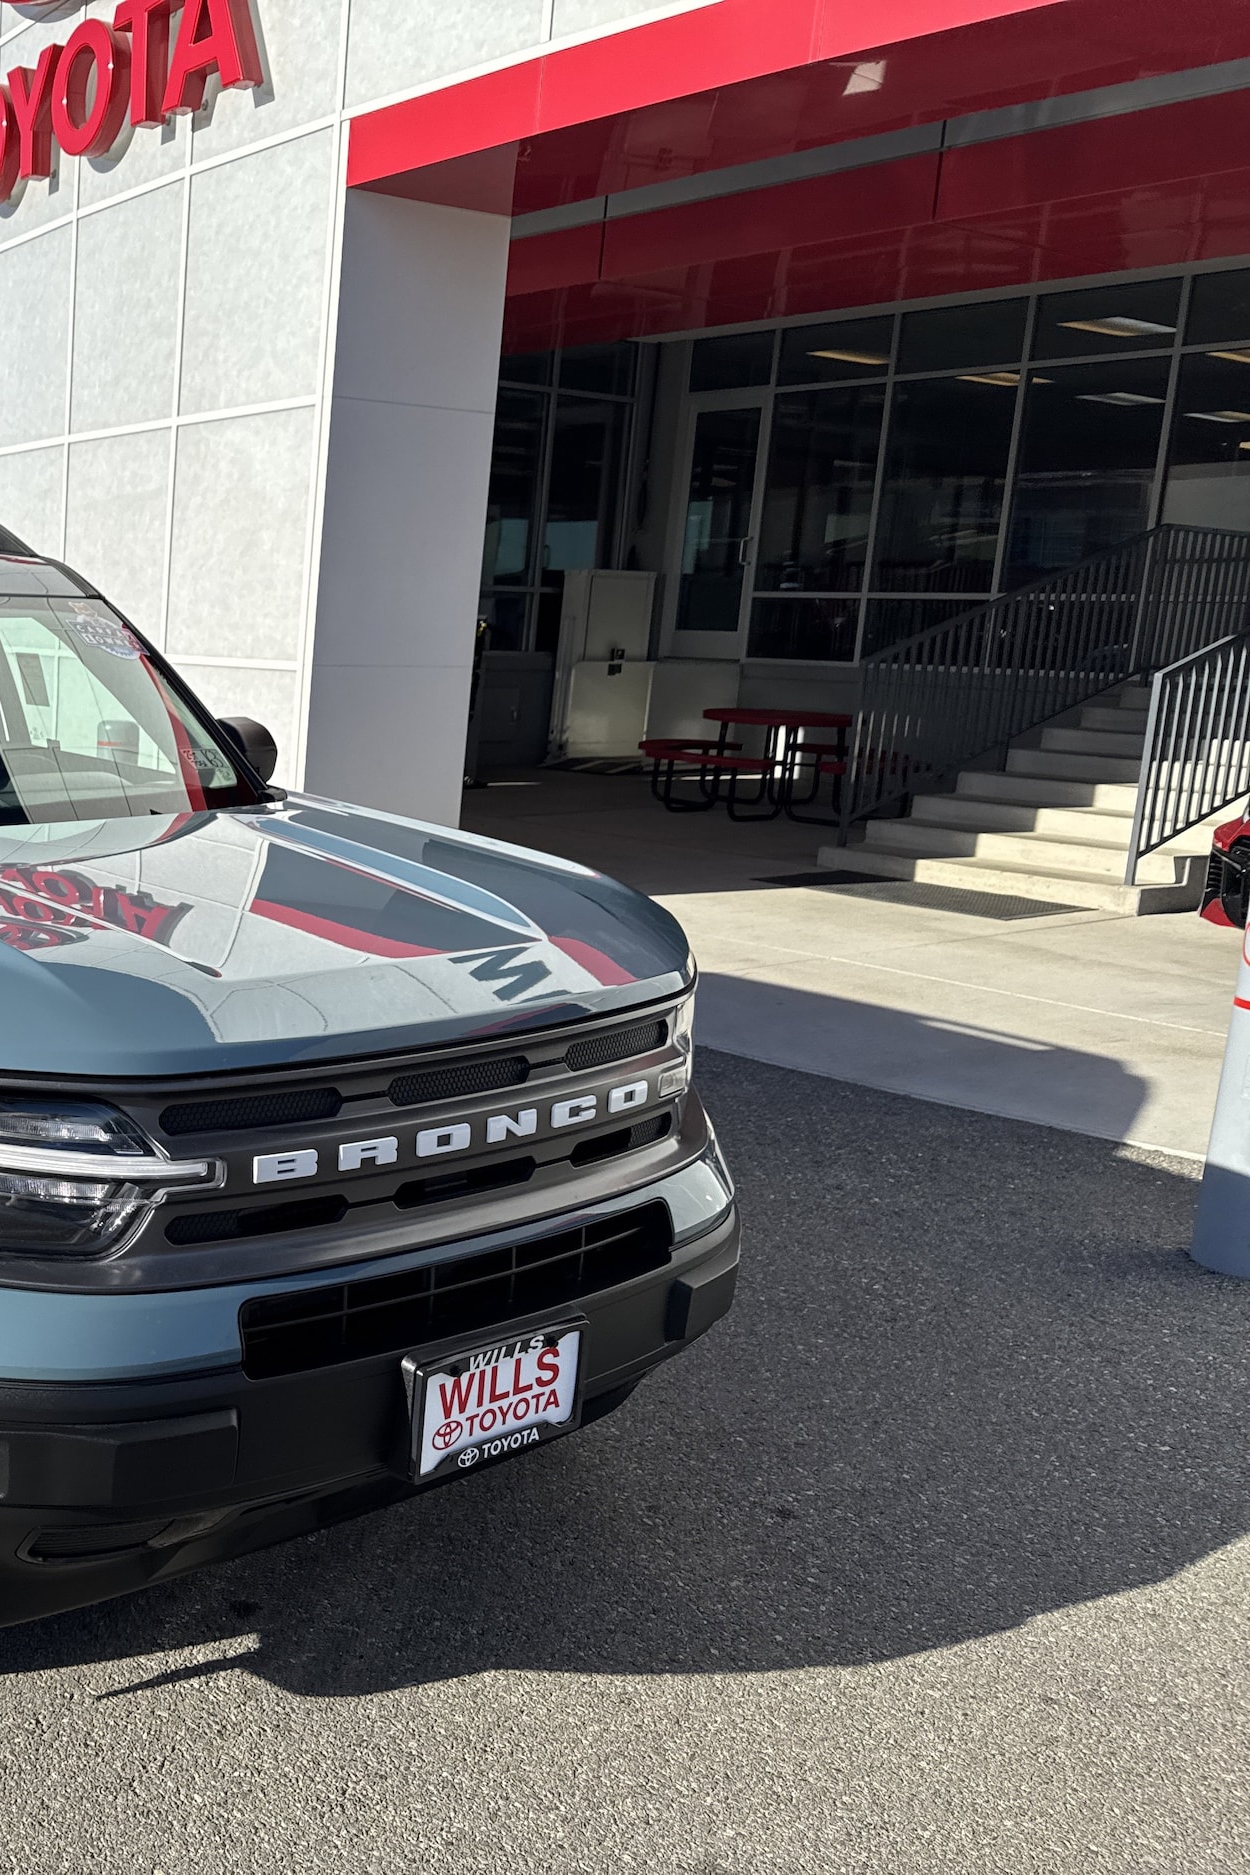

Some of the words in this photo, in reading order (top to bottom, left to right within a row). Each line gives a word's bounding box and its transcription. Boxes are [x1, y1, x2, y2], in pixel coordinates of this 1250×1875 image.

[252, 1080, 649, 1184] BRONCO
[469, 1334, 545, 1371] WILLS
[438, 1346, 560, 1420] WILLS
[465, 1388, 560, 1437] TOYOTA
[481, 1427, 540, 1458] TOYOTA
